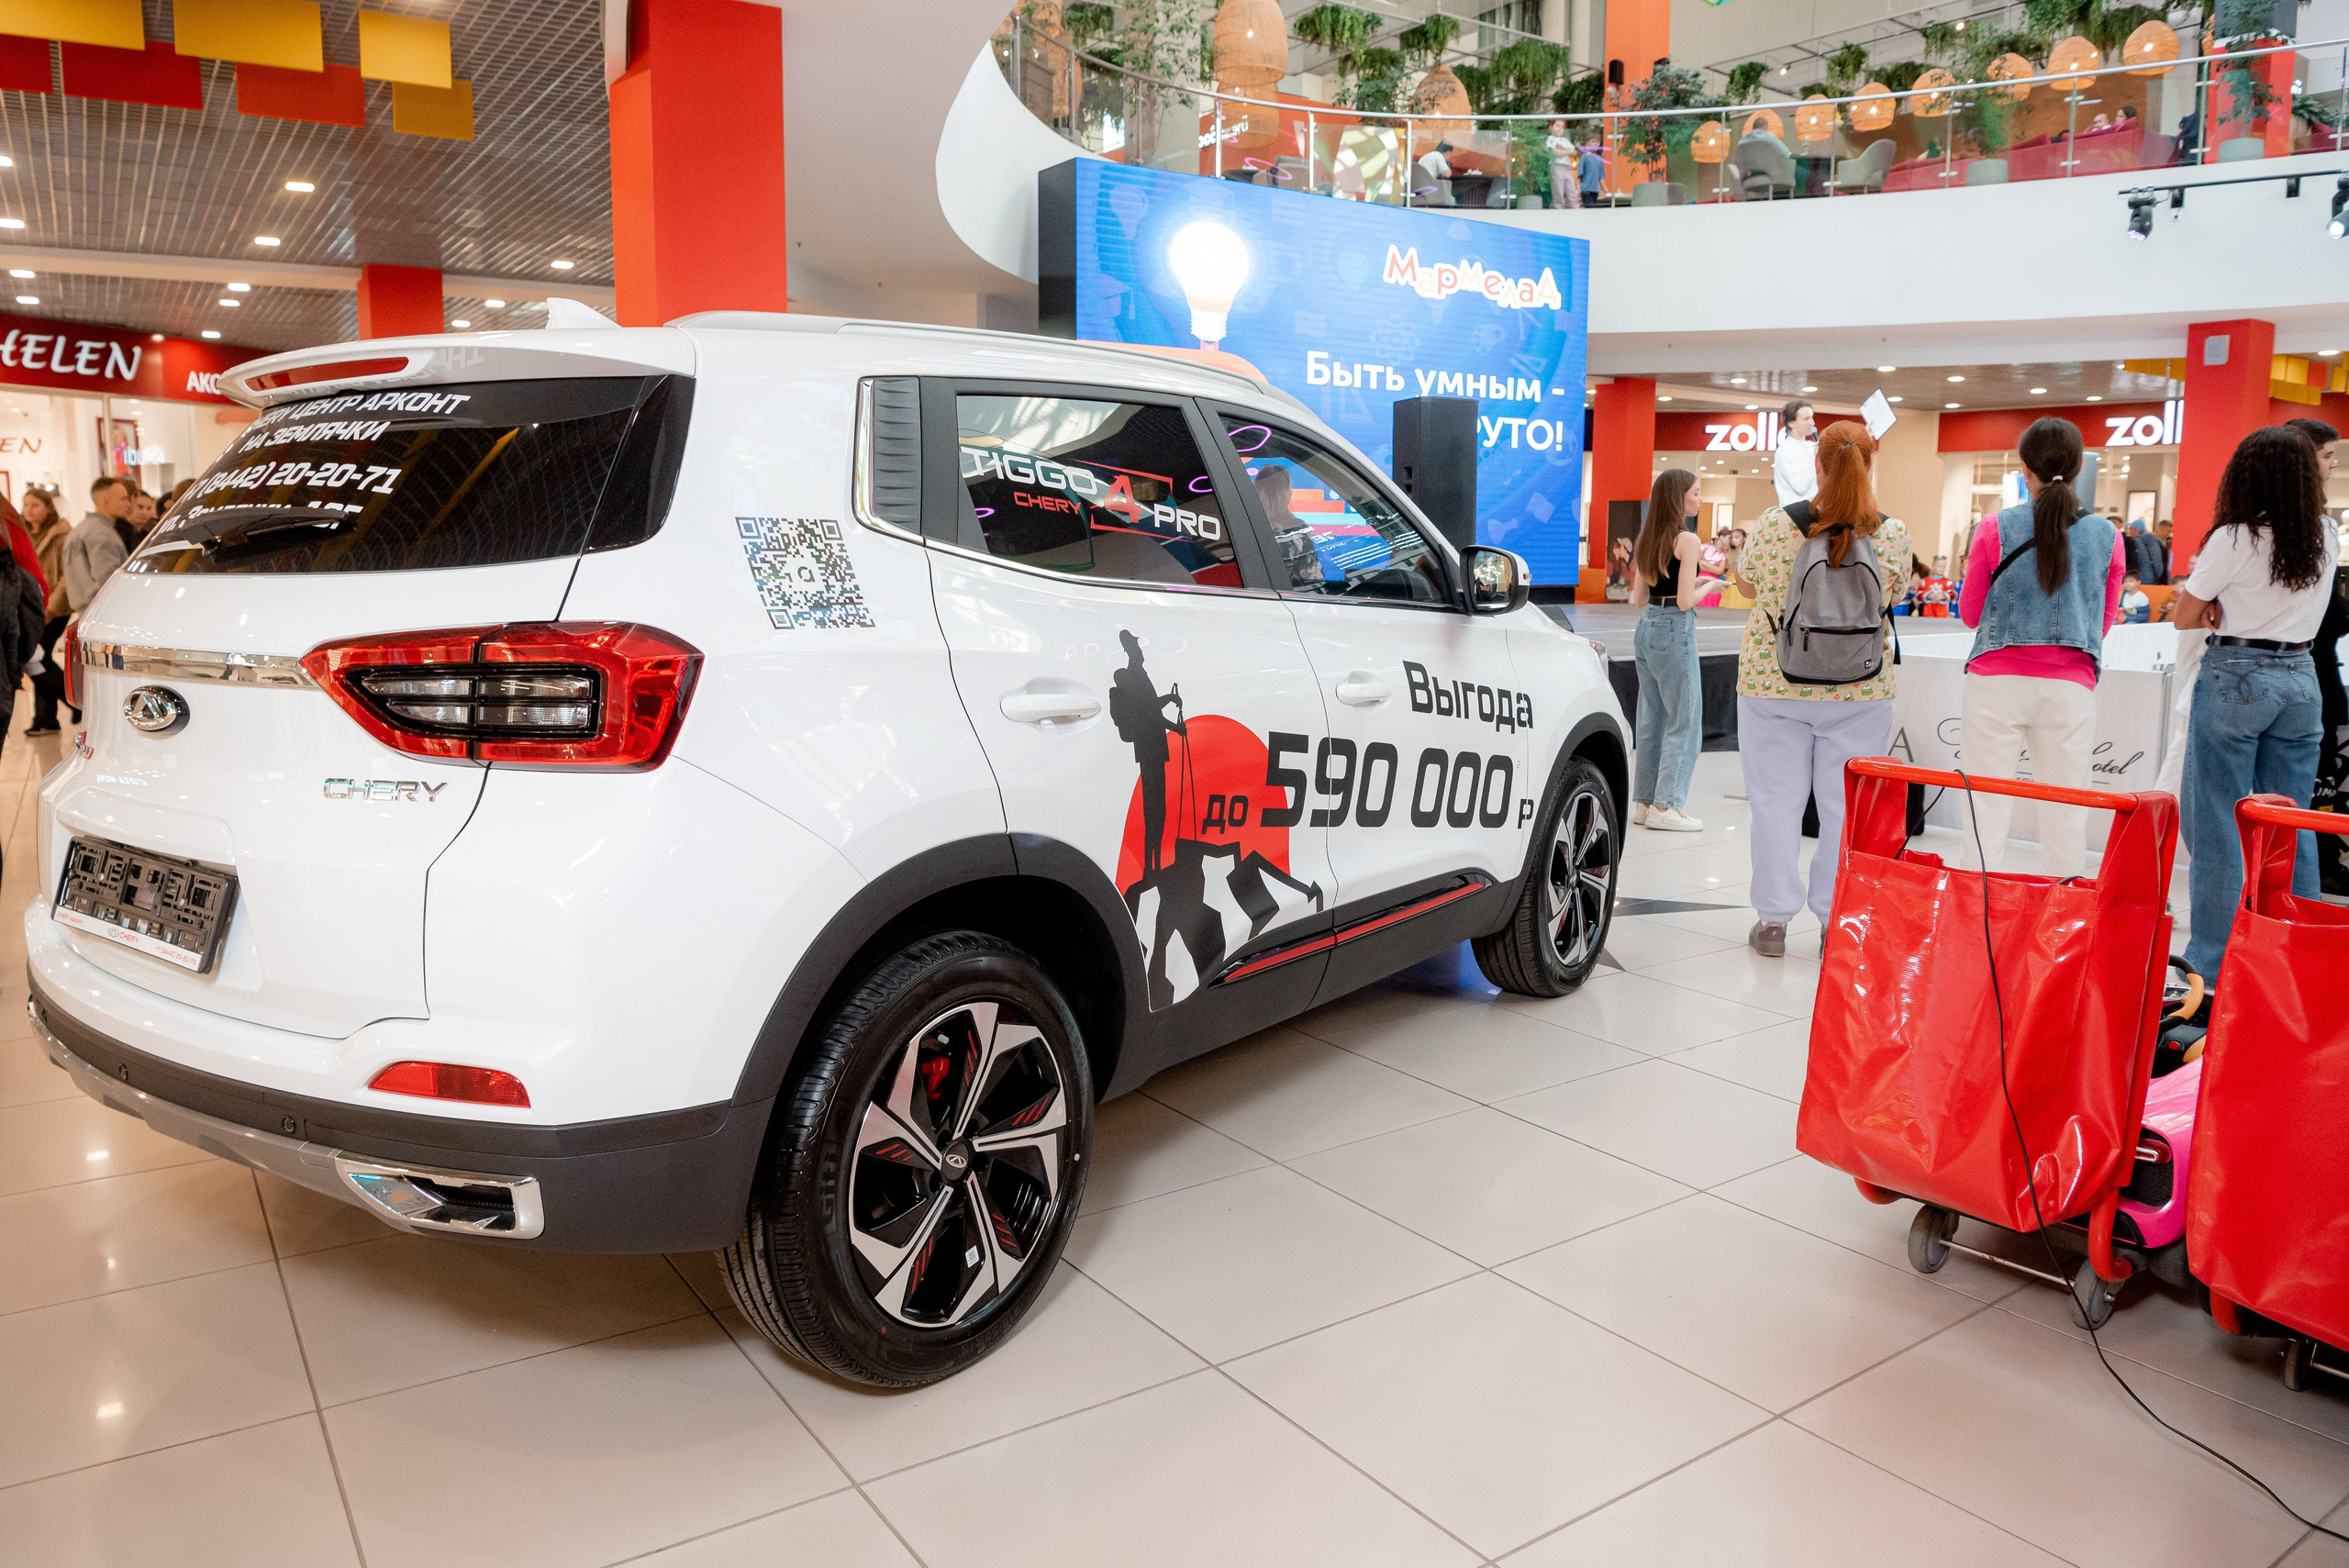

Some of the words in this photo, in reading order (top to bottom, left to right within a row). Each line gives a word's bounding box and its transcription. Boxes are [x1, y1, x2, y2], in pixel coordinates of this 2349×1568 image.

[1307, 350, 1406, 392] Быть
[1415, 368, 1542, 402] умным
[288, 395, 364, 420] ЦЕНТР
[356, 393, 471, 415] АРКОНТ
[238, 431, 273, 453] НА
[265, 421, 391, 447] ЗЕМЛЯЧКИ
[1705, 411, 1787, 451] zoll
[266, 462, 402, 494] 20-20-71
[961, 447, 1097, 495] TIGGO
[1103, 474, 1143, 524] 4
[1153, 504, 1220, 540] PRO
[1013, 492, 1082, 516] CHERY
[1403, 660, 1534, 734] Выгода
[323, 778, 449, 802] CHERY
[1202, 795, 1249, 835] до
[1261, 731, 1398, 828] 590
[1410, 747, 1514, 828] 000
[119, 931, 139, 943] CHERY
